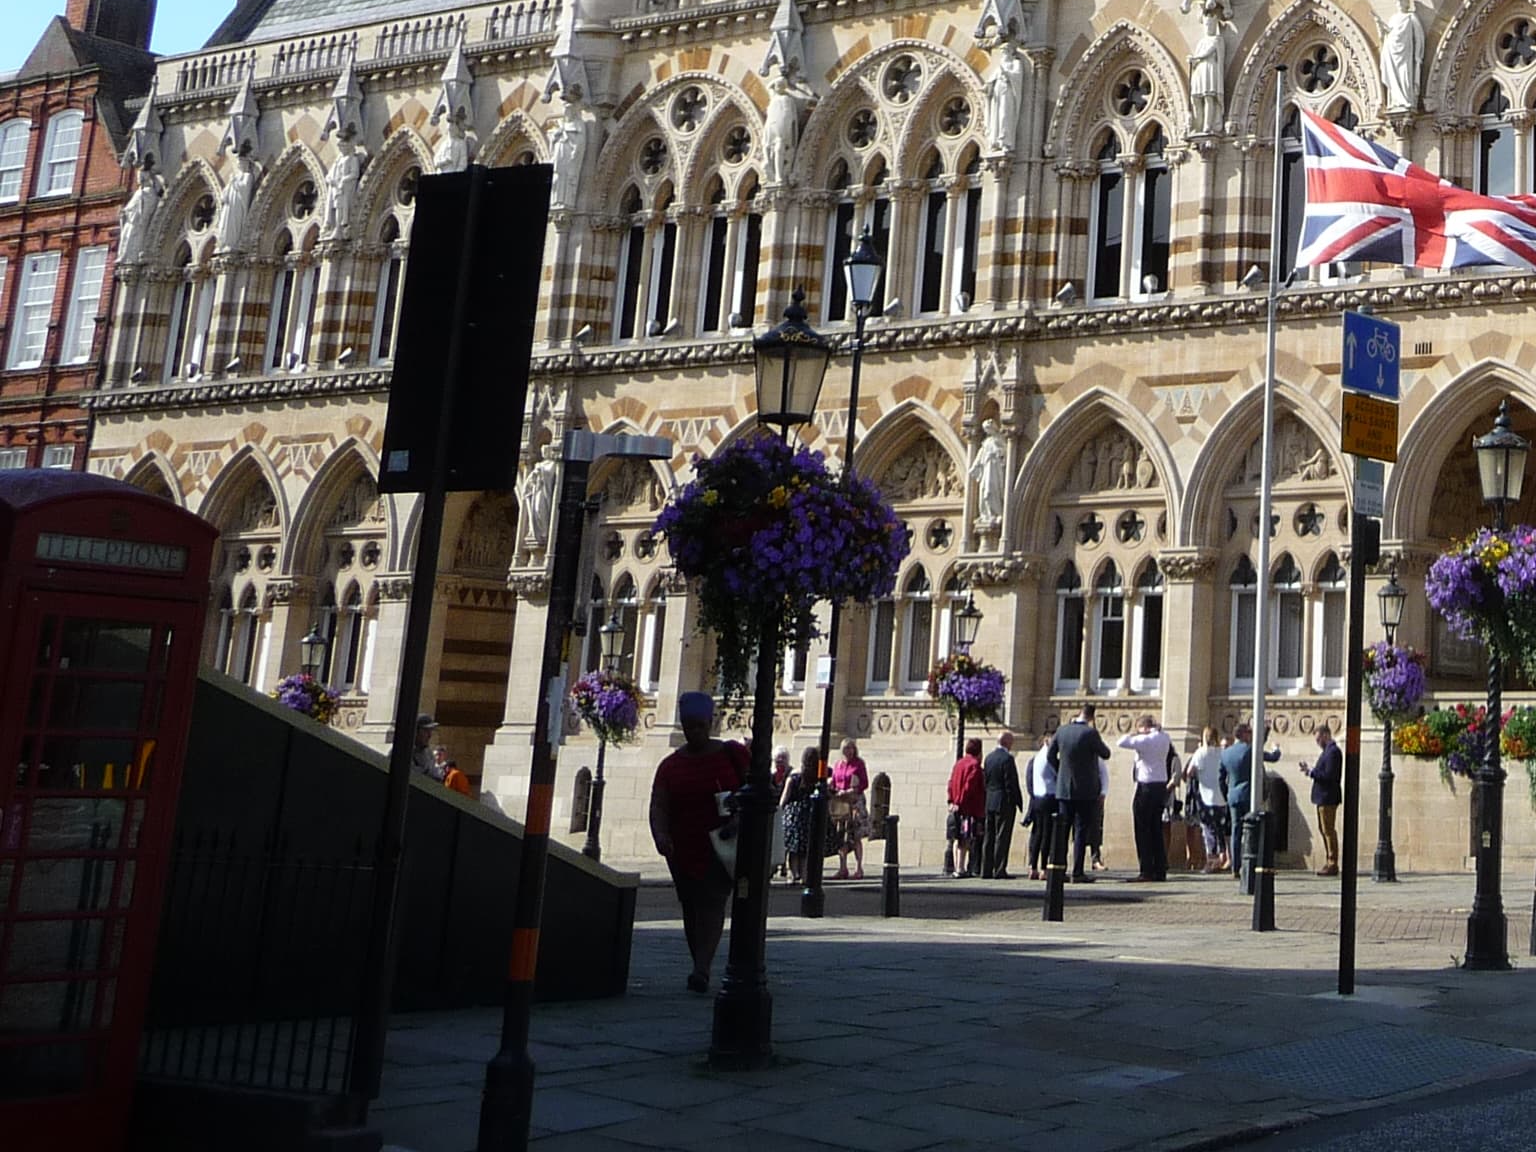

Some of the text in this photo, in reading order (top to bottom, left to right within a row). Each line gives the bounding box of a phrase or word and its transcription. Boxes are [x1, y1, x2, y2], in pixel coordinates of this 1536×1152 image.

[1355, 399, 1384, 416] ACCESS
[1354, 414, 1367, 425] ALL
[46, 535, 178, 569] TELEPHONE
